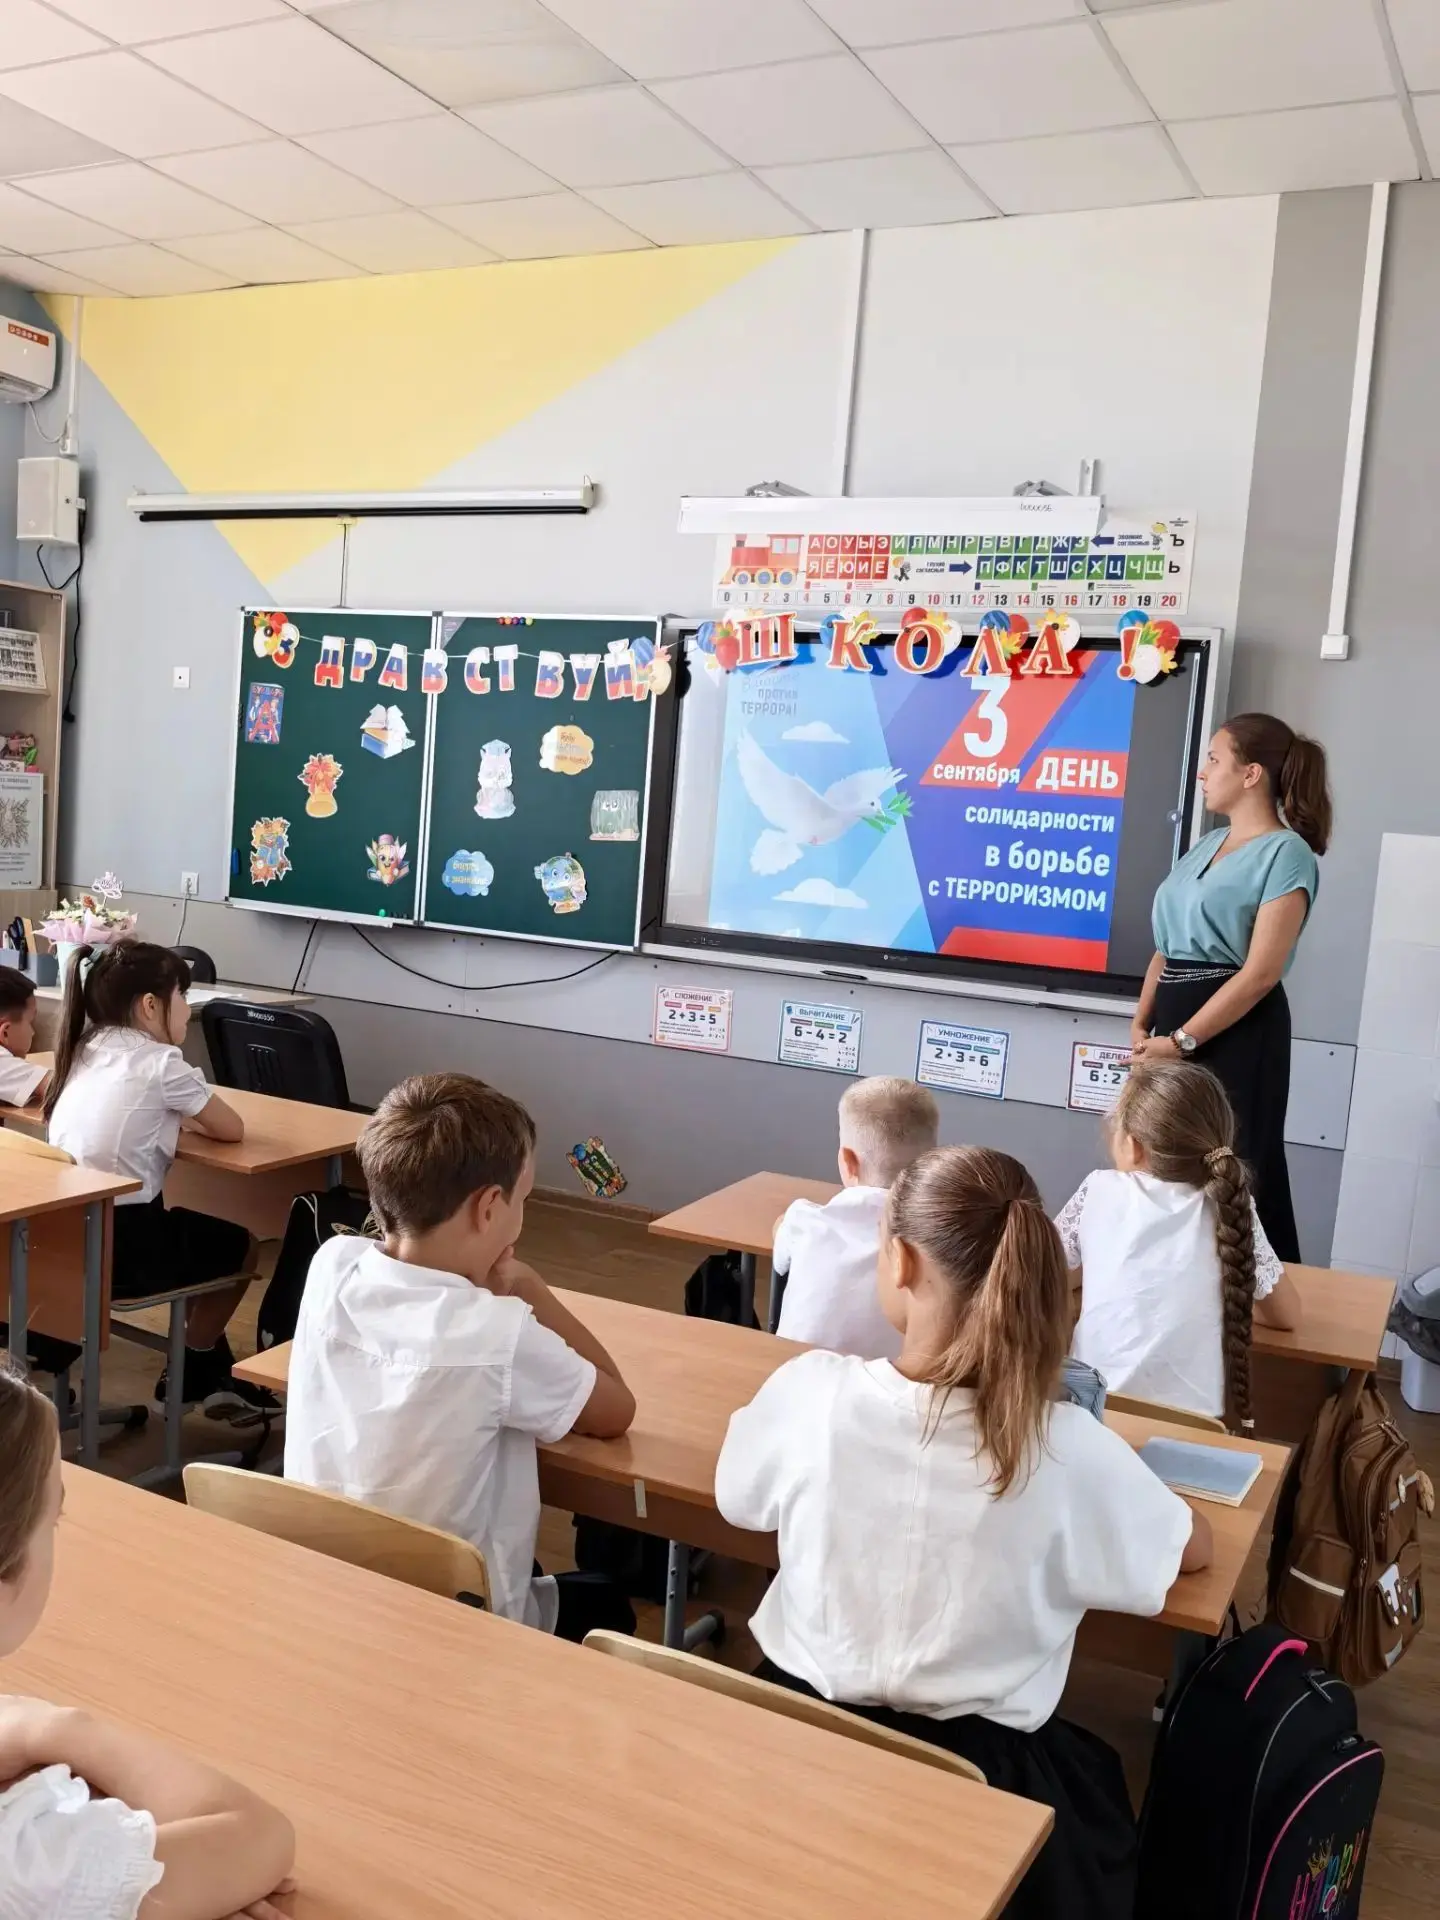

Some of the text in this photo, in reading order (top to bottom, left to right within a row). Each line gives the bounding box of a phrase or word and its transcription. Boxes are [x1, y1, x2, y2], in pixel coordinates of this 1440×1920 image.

[810, 536, 1084, 550] А О У Ы Э И Л М Н Р Б В Г Д Ж З
[1170, 534, 1185, 547] Ъ
[809, 558, 885, 573] Я Ё Ю И Е
[980, 560, 1181, 577] П Ф К Т Ш С Х Ц Ч Щ Ь
[724, 592, 1177, 607] 0 1 2 3 4 5 6 7 8 9 10 11 12 13 14 15 16 17 18 19 20
[961, 676, 1012, 758] 3
[933, 757, 1119, 791] сентября ДЕНЬ
[965, 806, 1115, 833] солидарности
[985, 840, 1110, 877] в борьбе
[928, 877, 1107, 912] с ТЕРРОРИЗМОМ
[674, 992, 712, 1002] СЛОЖЕНИЕ
[668, 1009, 676, 1019] 2
[688, 1012, 696, 1022] 3
[708, 1014, 716, 1025] 5
[800, 1009, 846, 1020] ВЫЧИТАНИЕ
[794, 1026, 803, 1037] 6
[816, 1029, 825, 1040] 4
[838, 1032, 847, 1043] 2
[938, 1028, 991, 1043] УМНОЖЕНИЕ
[934, 1047, 943, 1059] 2
[955, 1051, 965, 1063] 3
[980, 1055, 989, 1067] 6
[1099, 1051, 1132, 1061] ДЕЛЕН
[1090, 1070, 1099, 1082] 6
[1111, 1072, 1121, 1085] 2
